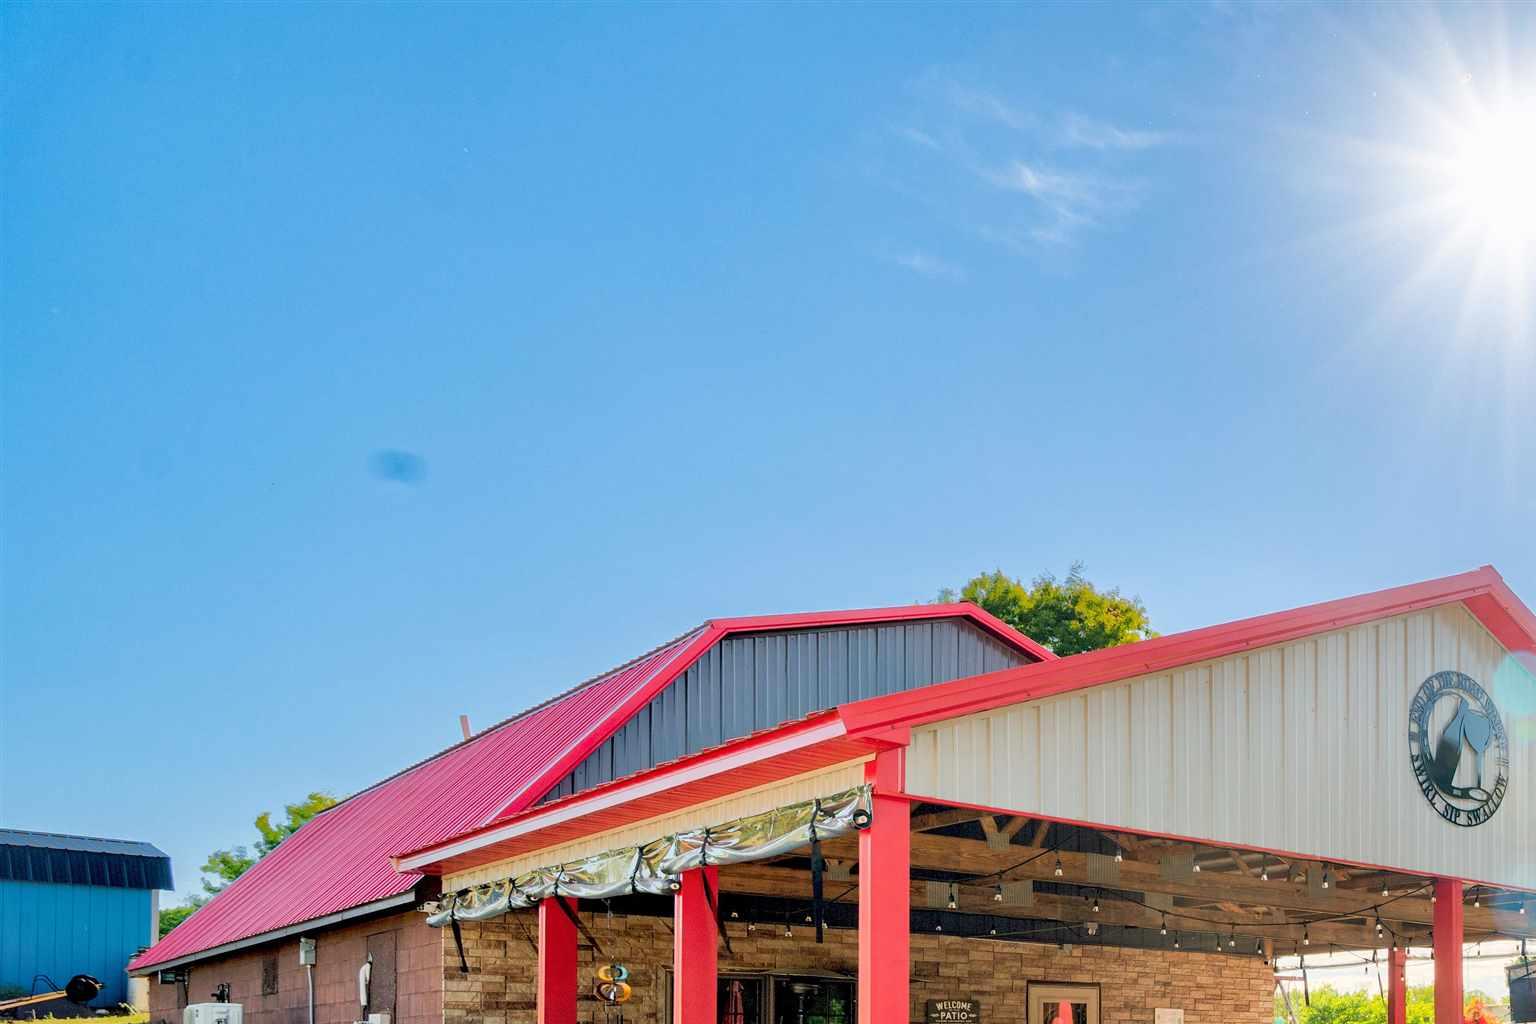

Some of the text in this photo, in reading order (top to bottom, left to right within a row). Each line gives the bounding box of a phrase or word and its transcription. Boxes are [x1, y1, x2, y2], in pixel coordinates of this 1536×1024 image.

[1443, 803, 1461, 823] SIP
[936, 1001, 972, 1011] WELCOME
[940, 1012, 968, 1020] PATIO
